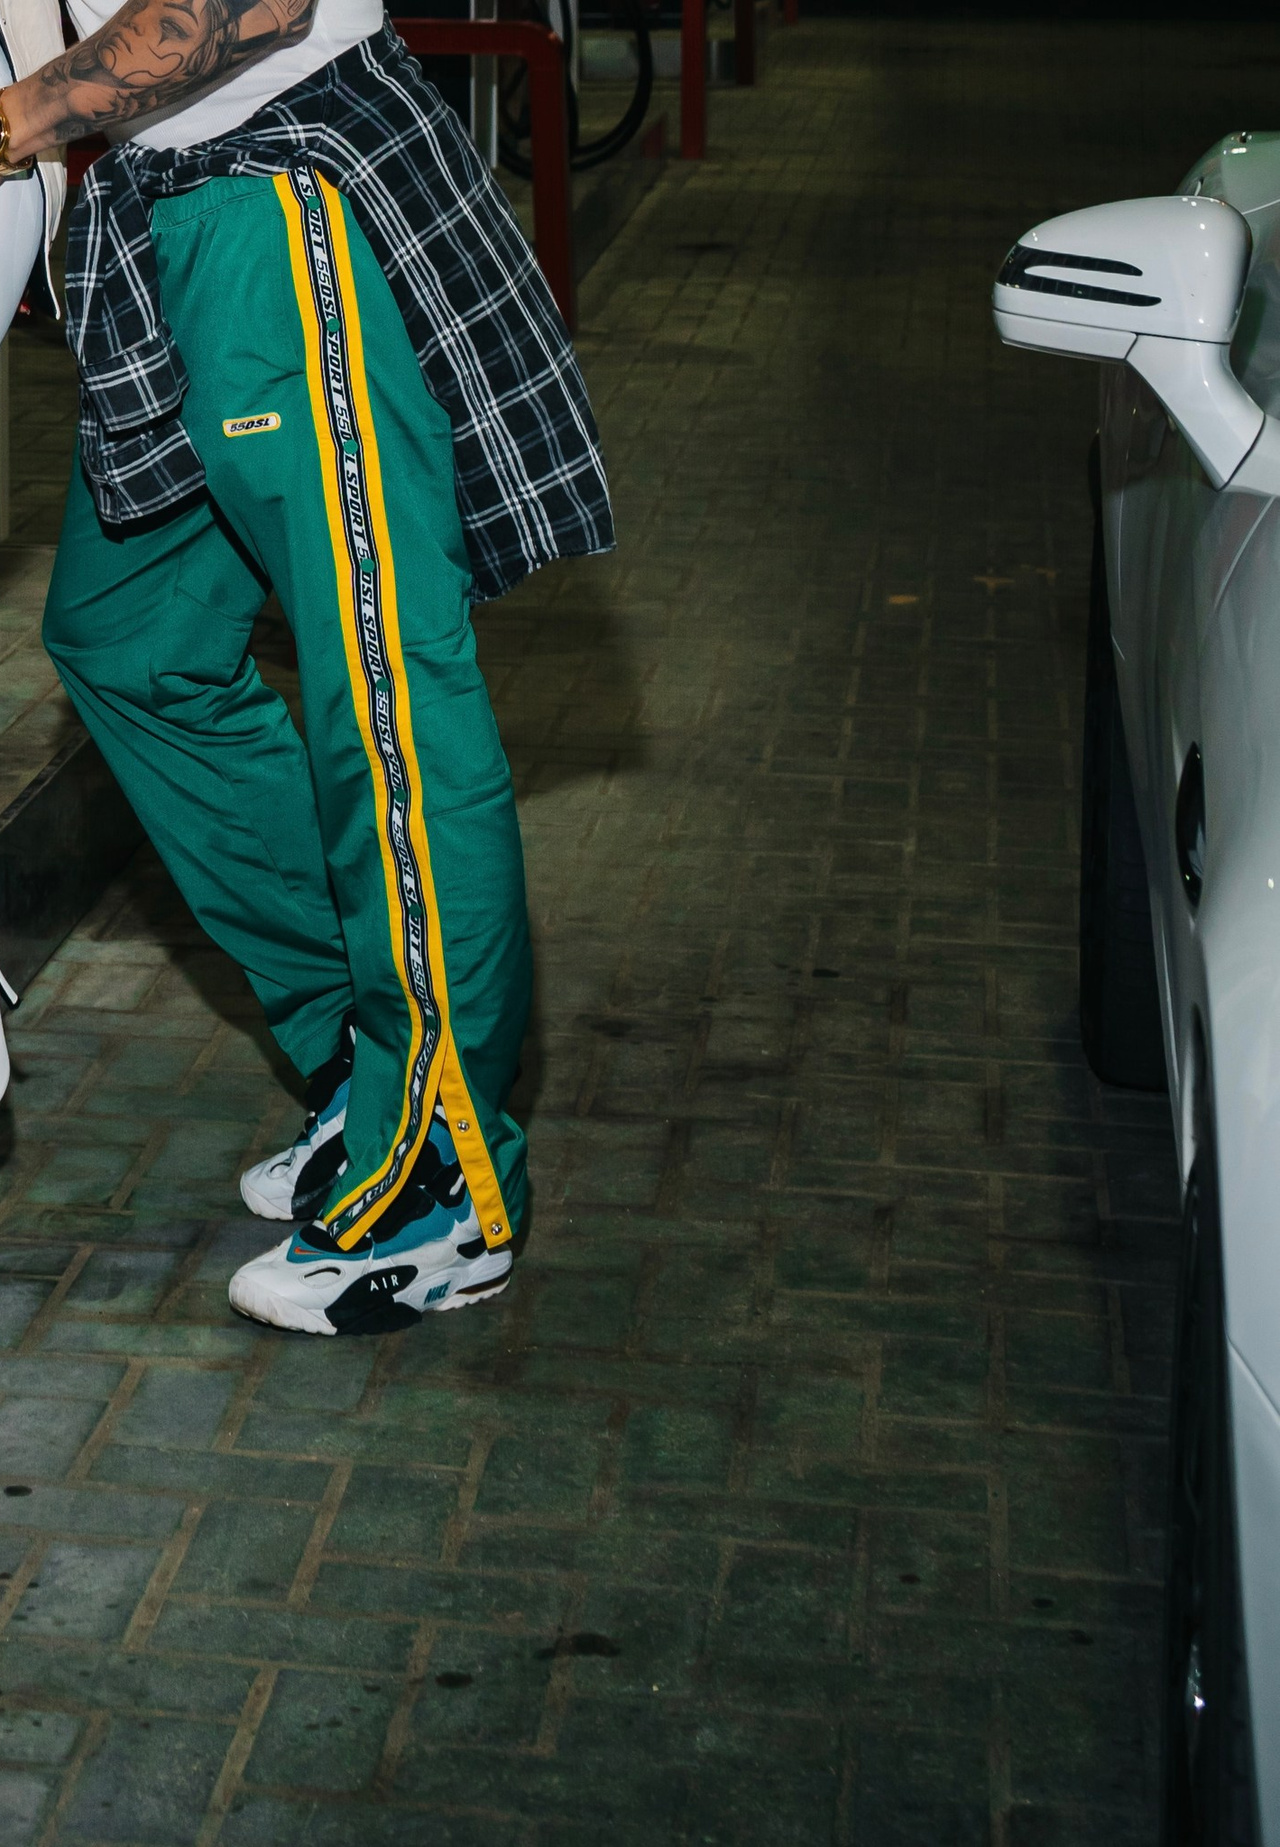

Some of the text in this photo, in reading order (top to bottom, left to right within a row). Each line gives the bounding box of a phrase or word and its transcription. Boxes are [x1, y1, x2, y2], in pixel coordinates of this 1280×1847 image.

[300, 182, 324, 254] SORT
[316, 258, 336, 320] 55DSL
[328, 329, 345, 401] SPORT
[229, 418, 271, 433] 55DSL
[346, 470, 366, 543] SPORT
[356, 546, 373, 608] 5DSL
[363, 612, 385, 679] SPORT
[377, 689, 391, 746] 55DSL
[385, 750, 405, 820] SPOT
[393, 821, 413, 880] 55DSL
[370, 1274, 400, 1292] AIR
[423, 1280, 452, 1305] NIKE
